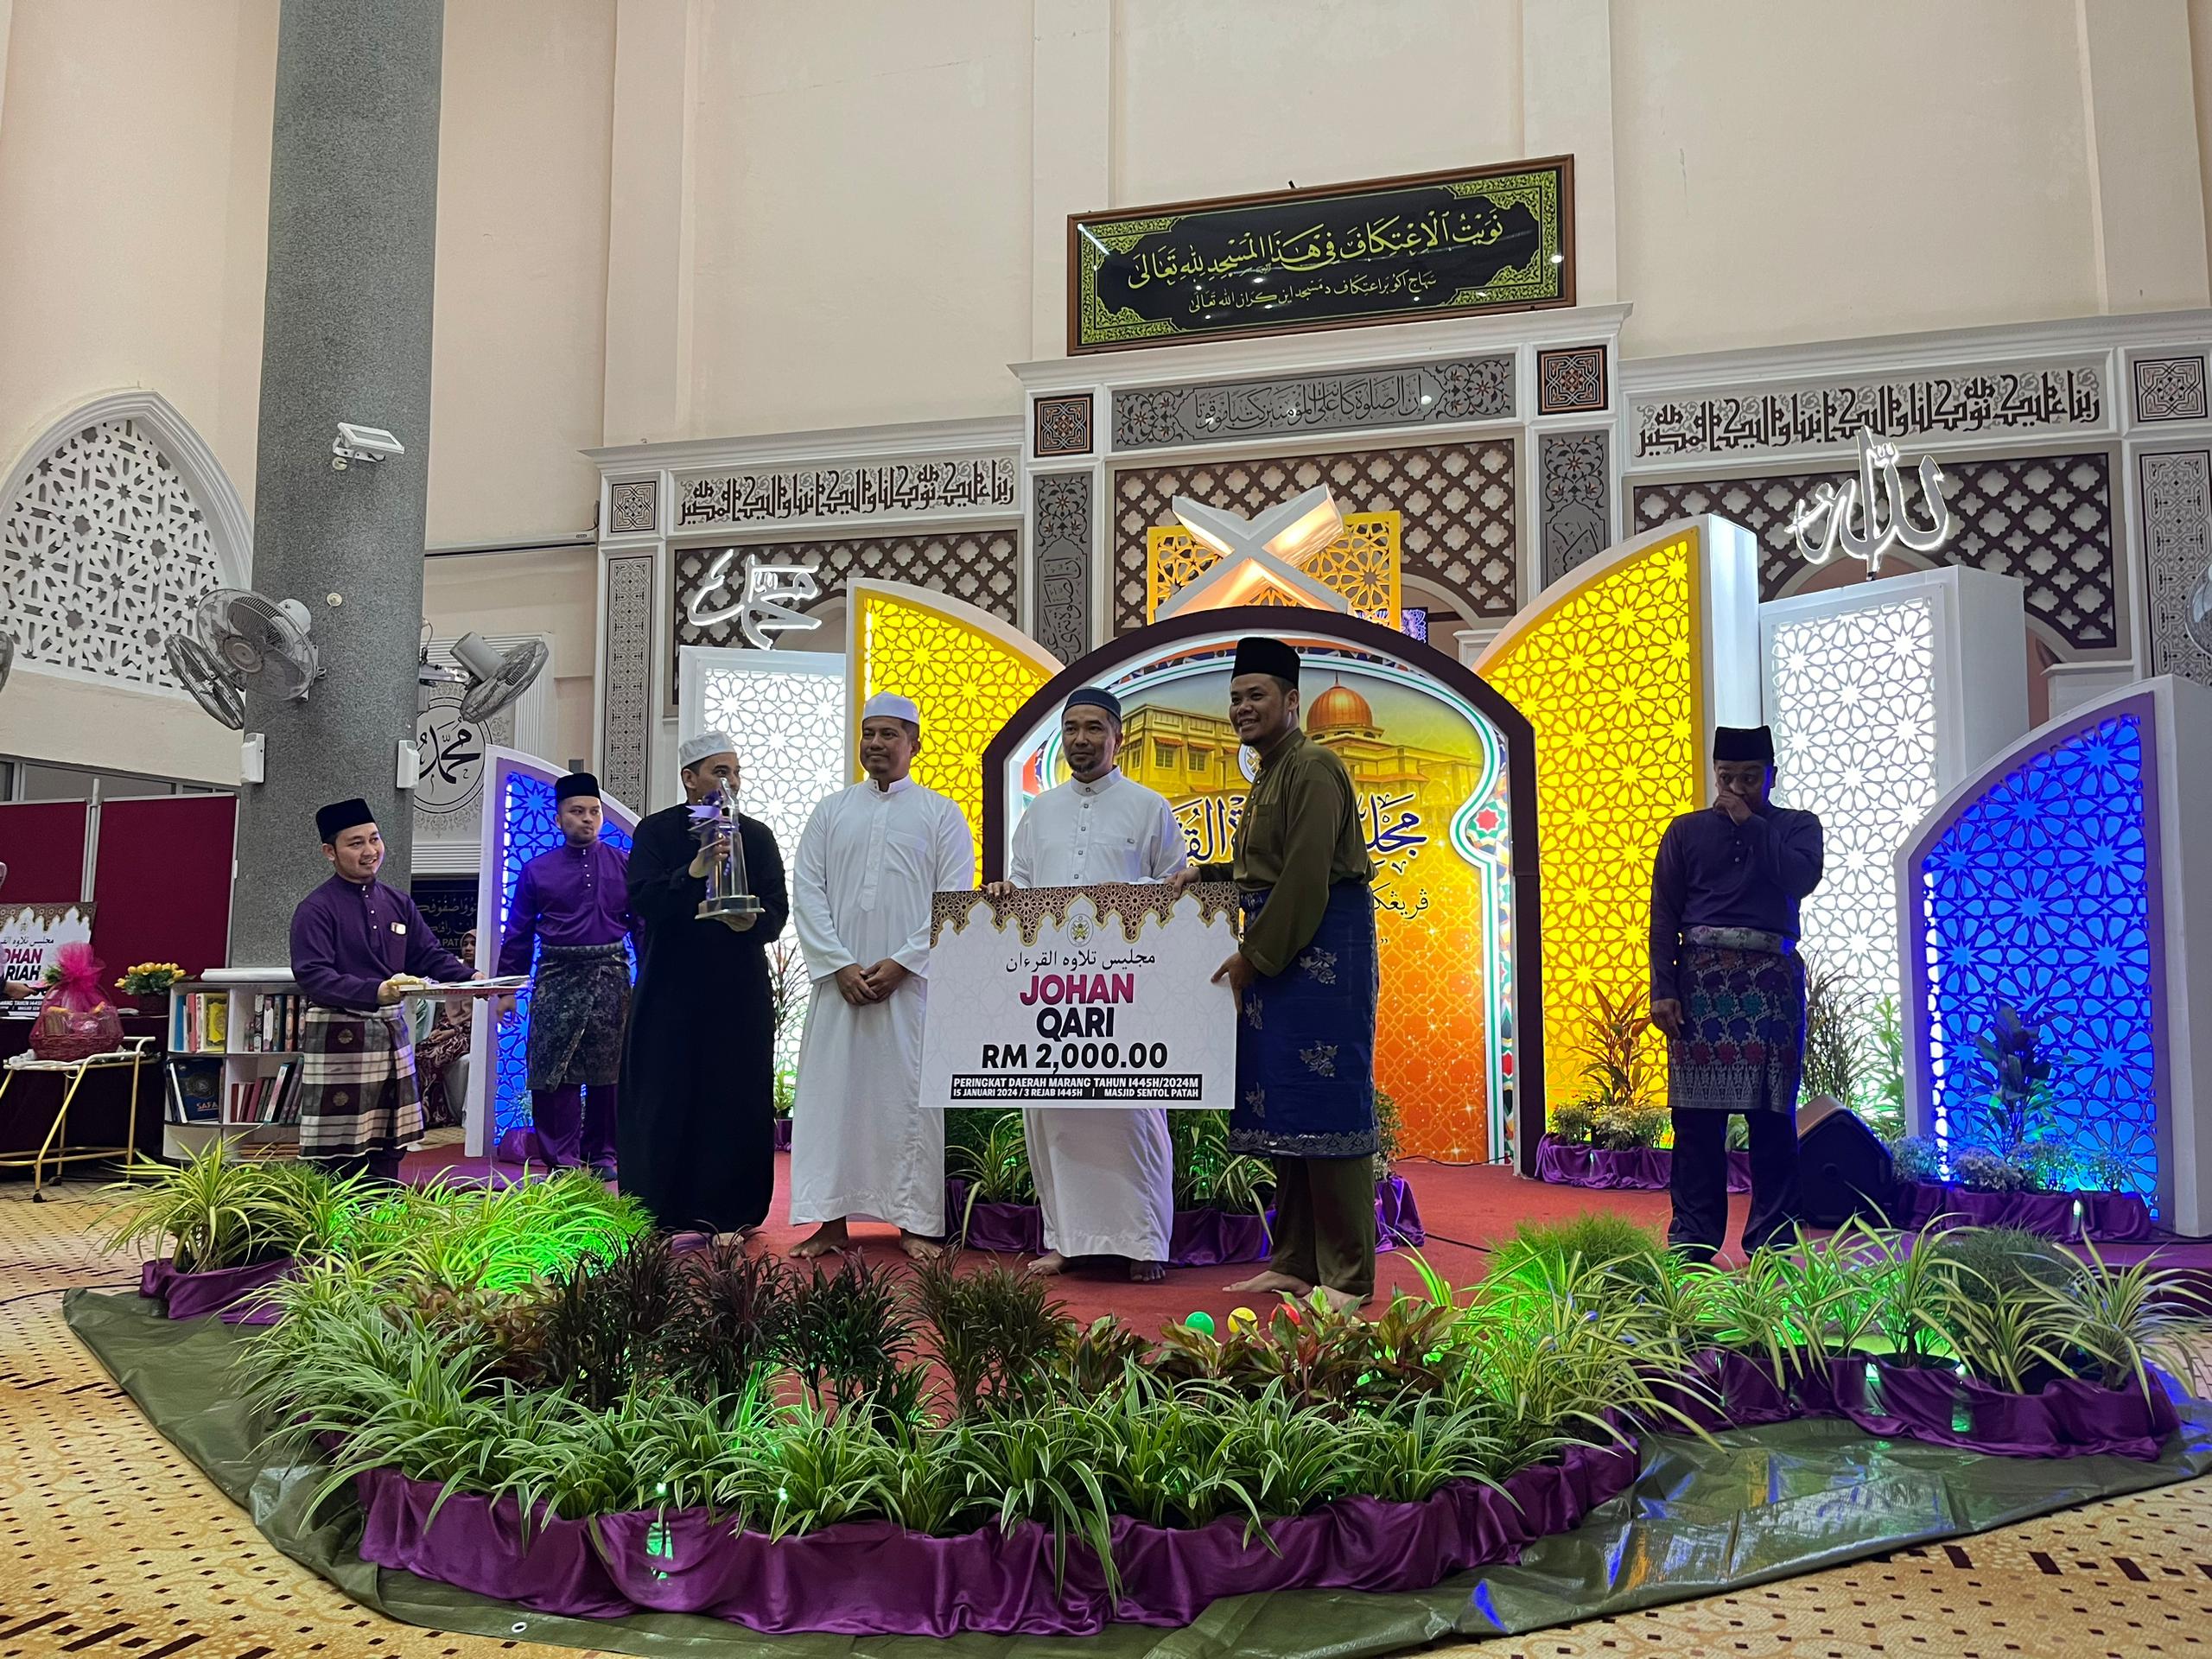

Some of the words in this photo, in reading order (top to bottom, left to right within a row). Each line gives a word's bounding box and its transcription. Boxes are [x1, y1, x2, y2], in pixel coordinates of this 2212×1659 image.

[1020, 974, 1135, 1006] JOHAN
[1036, 1007, 1115, 1042] QARI
[982, 1044, 1027, 1069] RM
[1035, 1043, 1167, 1075] 2,000.00
[953, 1077, 1007, 1088] PERINGKAT
[1008, 1077, 1046, 1087] DAERAH
[1048, 1077, 1090, 1087] MARANG
[1094, 1077, 1126, 1087] TAHUN
[963, 1088, 995, 1096] JANUARI
[997, 1088, 1017, 1096] 2024
[1104, 1088, 1135, 1097] MASJID
[1136, 1088, 1169, 1097] SENTOL
[1171, 1088, 1198, 1097] PATAH
